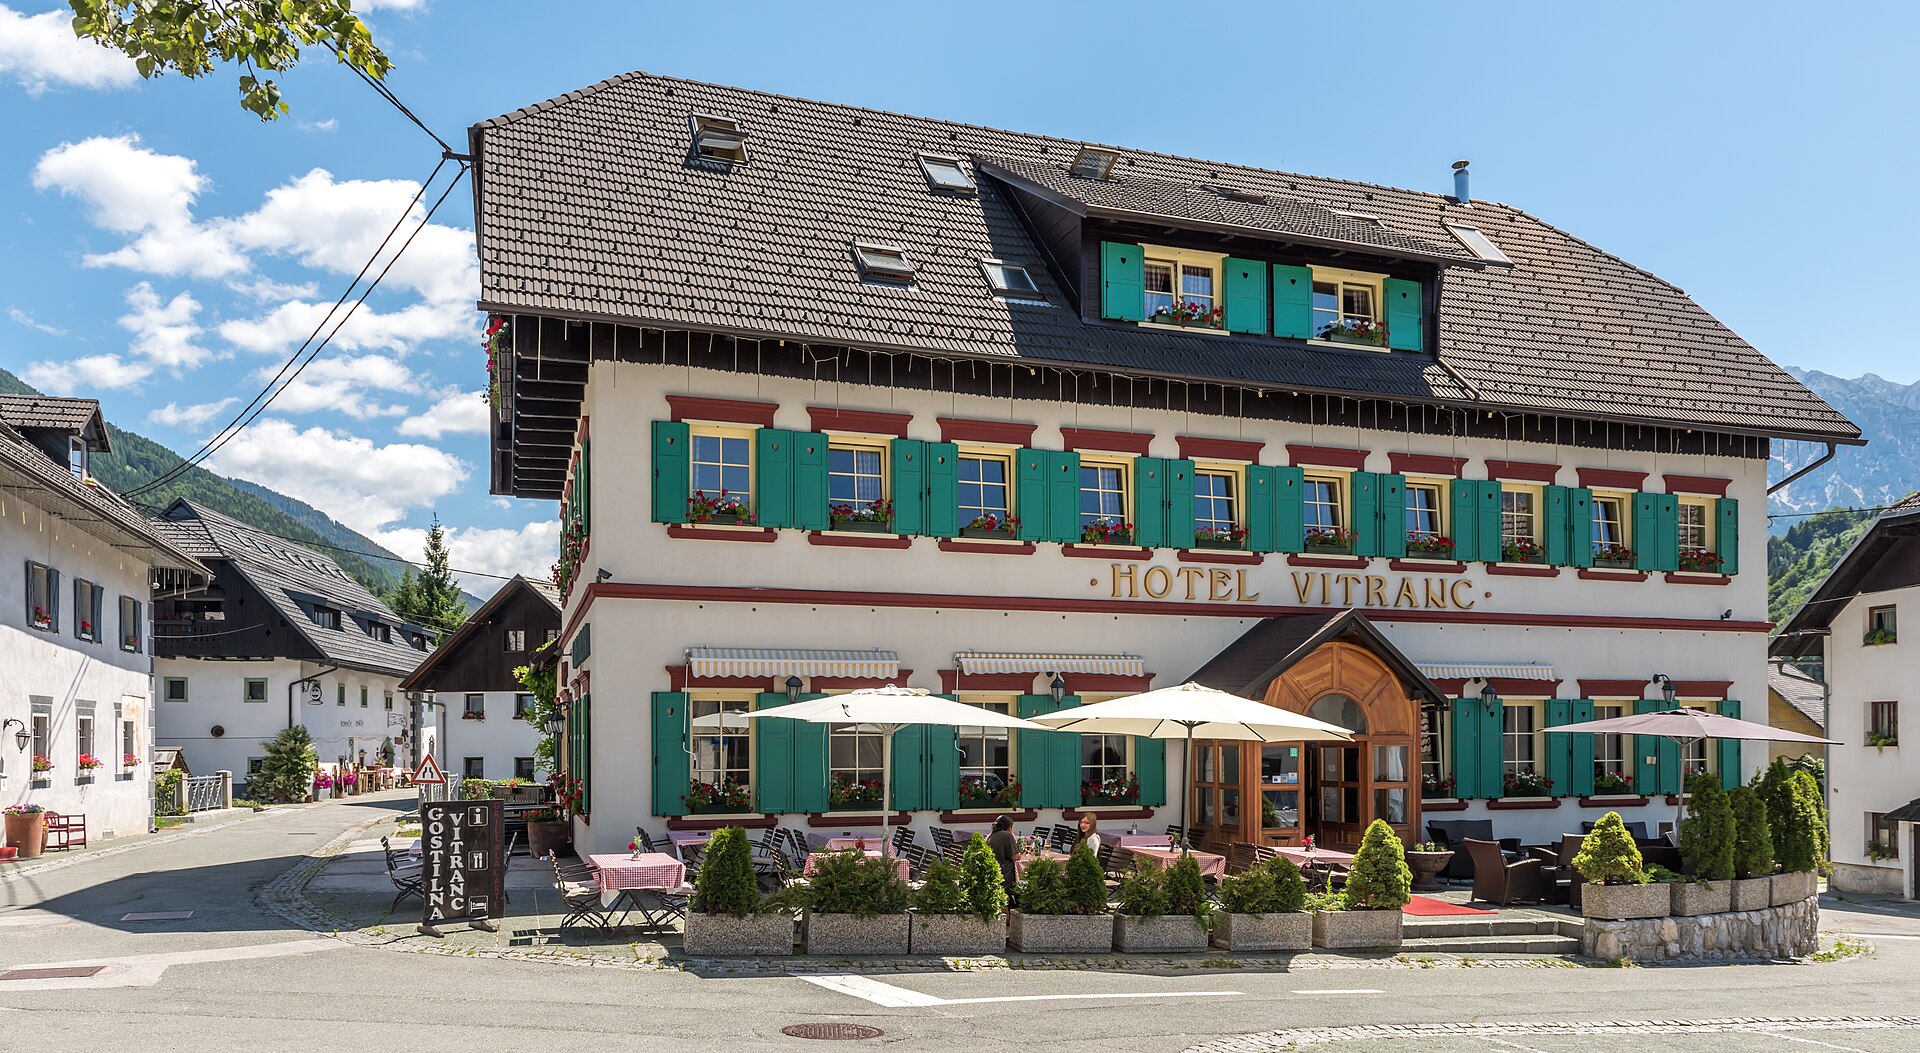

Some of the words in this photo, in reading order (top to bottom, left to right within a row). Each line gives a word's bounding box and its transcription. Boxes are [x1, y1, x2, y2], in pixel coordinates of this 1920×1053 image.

[1110, 564, 1260, 602] HOTEL
[1290, 571, 1476, 610] VITRANC
[427, 807, 445, 921] GOSTILNA
[449, 812, 465, 911] VITRANC
